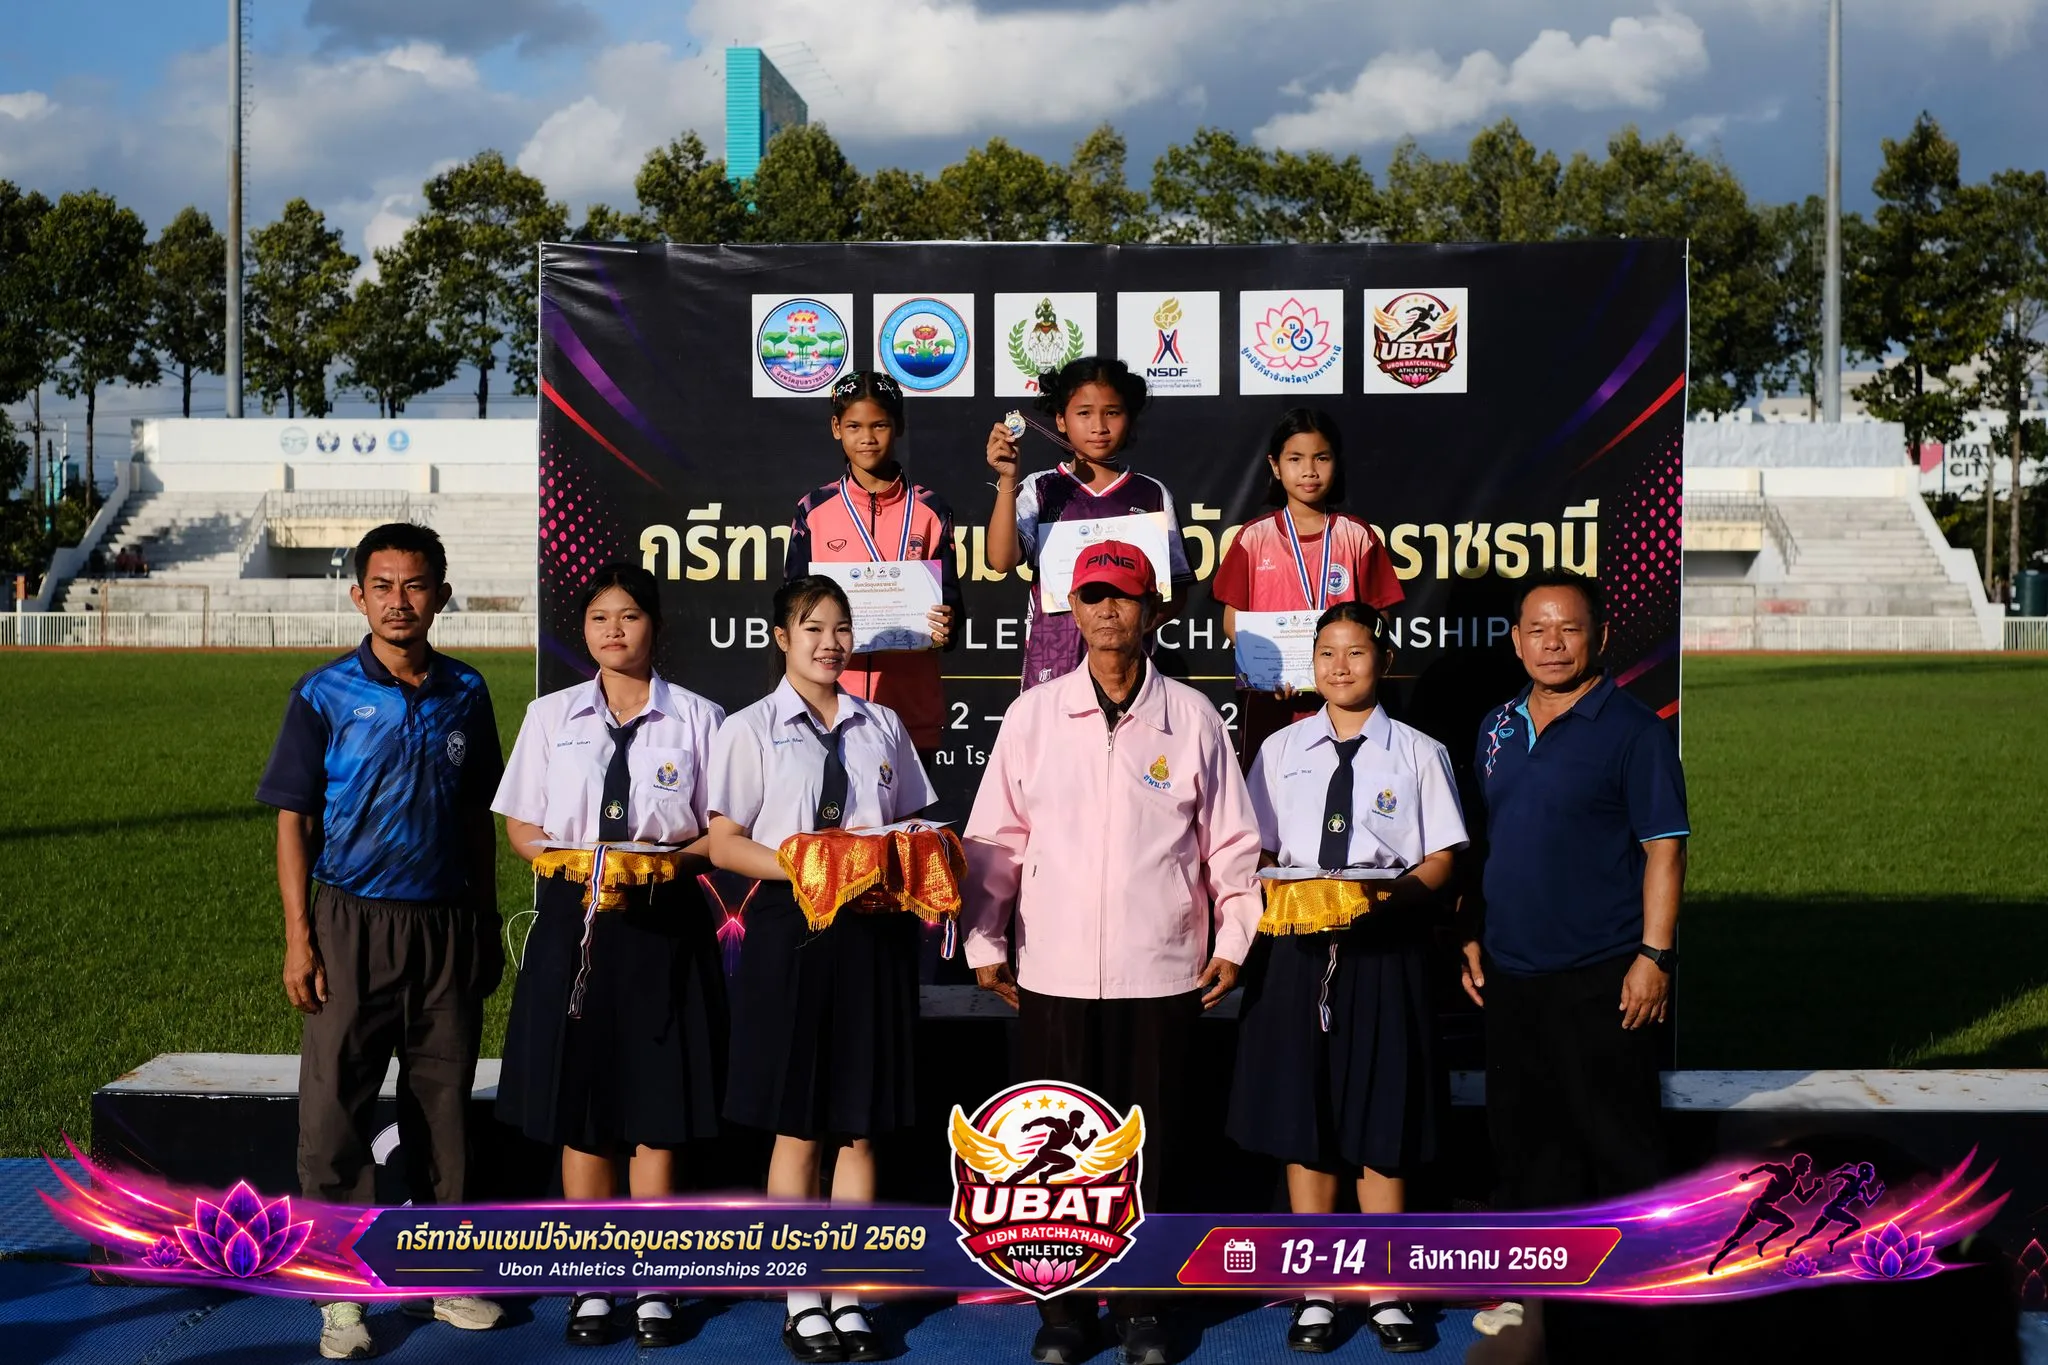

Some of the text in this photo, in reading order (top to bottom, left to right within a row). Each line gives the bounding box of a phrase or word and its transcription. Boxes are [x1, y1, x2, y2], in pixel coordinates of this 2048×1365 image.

[1381, 342, 1451, 361] UBAT
[1146, 367, 1188, 377] NSDF
[1085, 553, 1136, 571] PING
